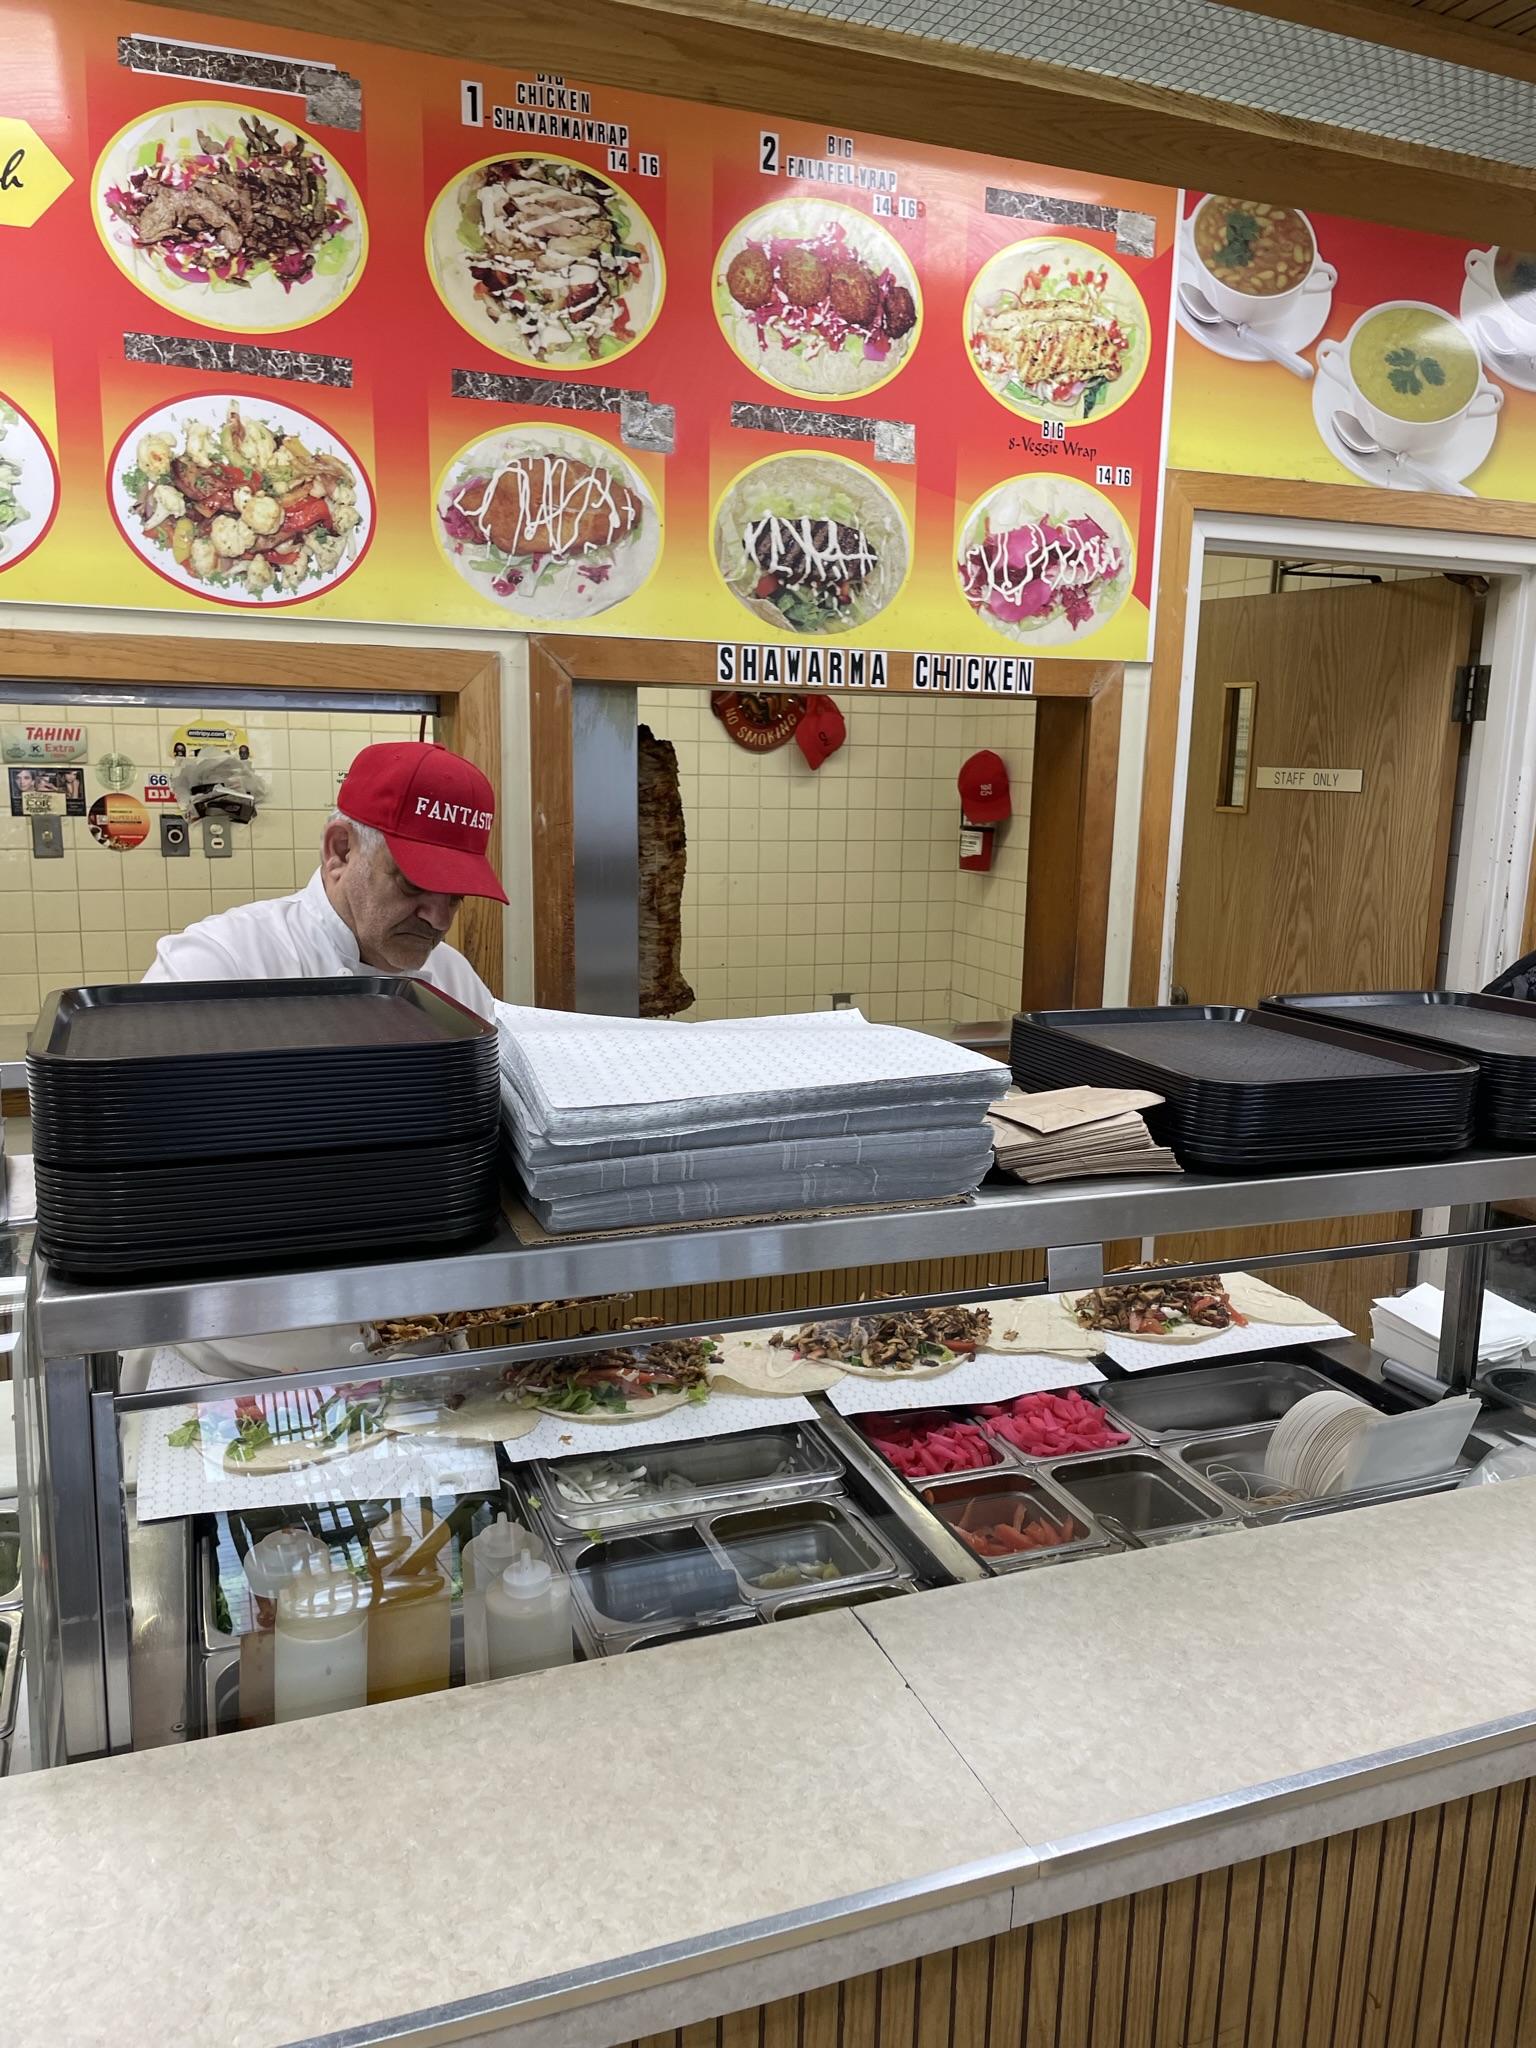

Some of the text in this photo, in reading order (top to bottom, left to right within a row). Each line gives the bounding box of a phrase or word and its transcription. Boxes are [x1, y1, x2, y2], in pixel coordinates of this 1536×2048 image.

[516, 83, 591, 114] CHICKEN
[585, 121, 628, 147] WRAP
[827, 135, 853, 158] BIG
[1043, 420, 1064, 439] BIG
[1008, 436, 1097, 462] 8-Veggie Wrap
[719, 646, 1033, 692] SHAWARMA CHICKEN
[26, 727, 82, 742] TAHINI
[725, 707, 739, 725] NO
[737, 713, 798, 746] SMOKING
[45, 743, 75, 753] Extra
[150, 774, 168, 786] 66
[1273, 771, 1340, 788] STAFF ONLY
